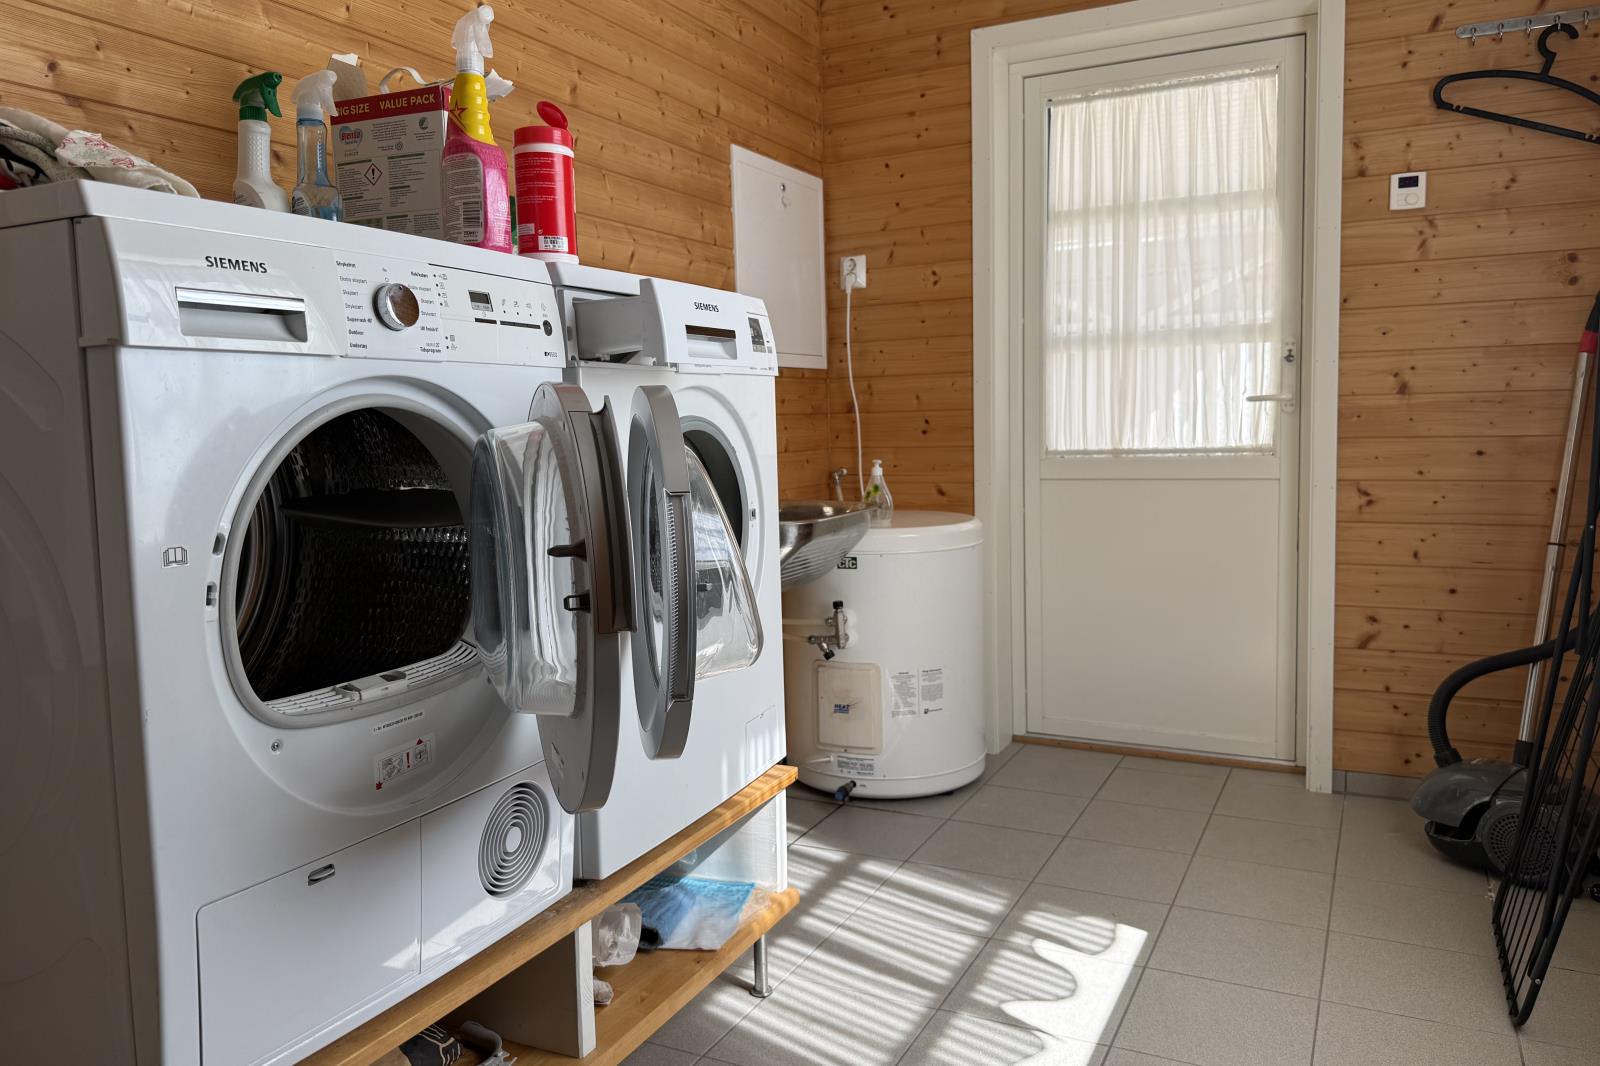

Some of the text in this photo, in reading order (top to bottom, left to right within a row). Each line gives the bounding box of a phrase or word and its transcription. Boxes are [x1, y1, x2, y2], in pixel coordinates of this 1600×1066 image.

[350, 103, 370, 115] SIZE
[379, 97, 408, 110] VALUE
[410, 93, 436, 105] PACK
[205, 255, 268, 274] SIEMENS
[693, 301, 720, 313] SIEMENS
